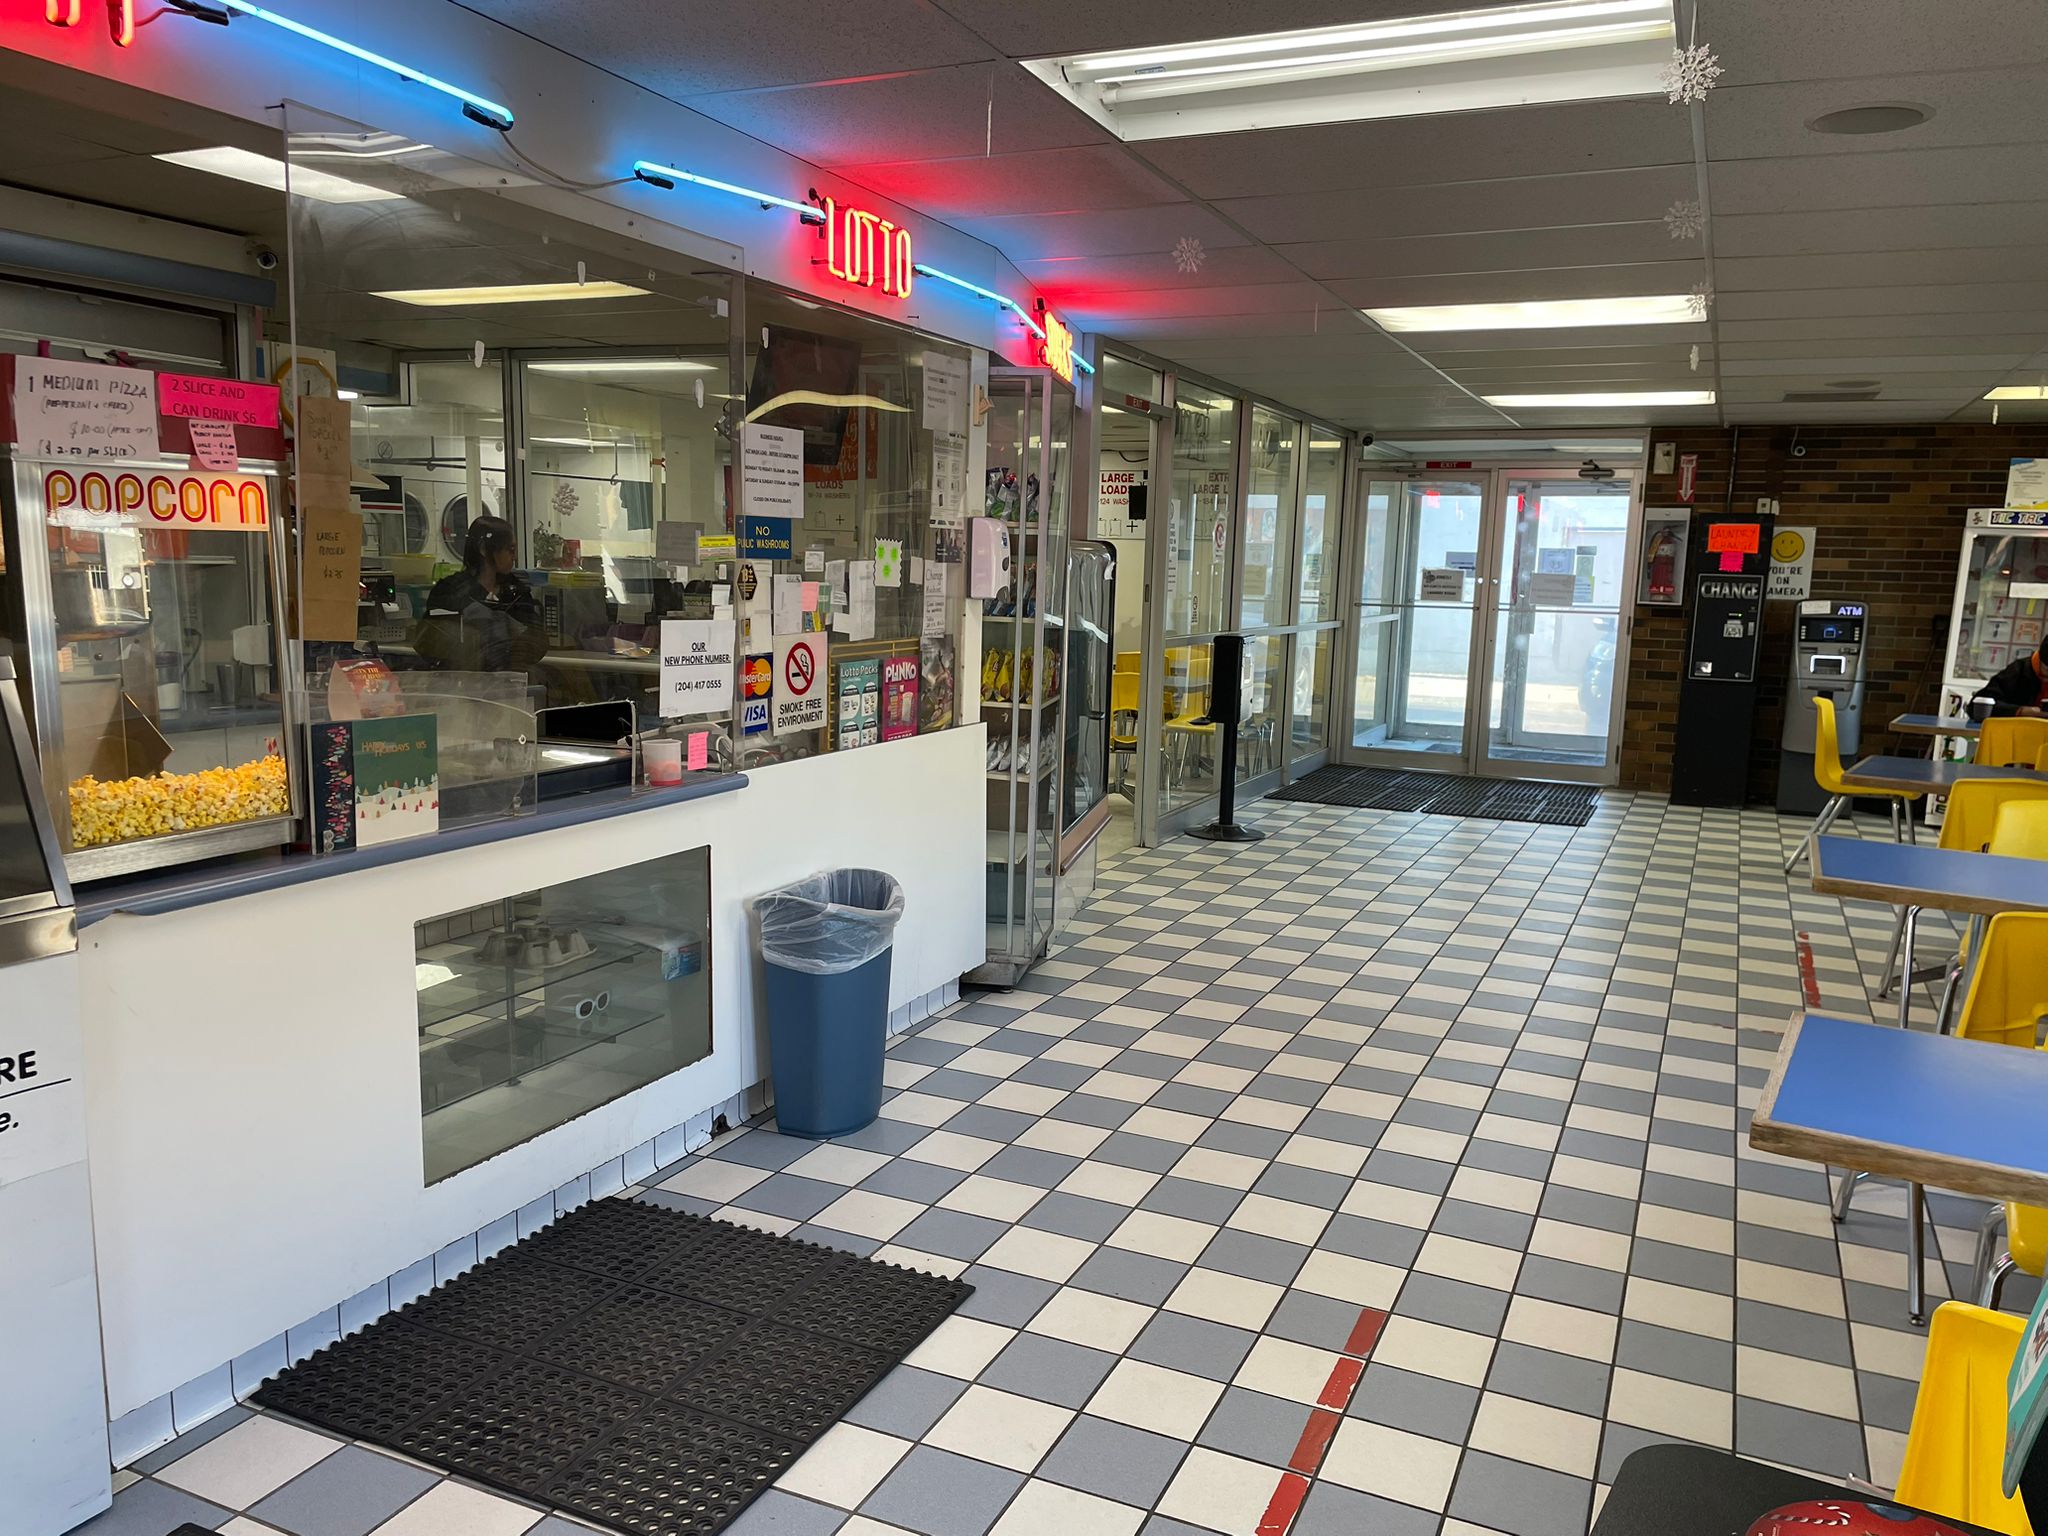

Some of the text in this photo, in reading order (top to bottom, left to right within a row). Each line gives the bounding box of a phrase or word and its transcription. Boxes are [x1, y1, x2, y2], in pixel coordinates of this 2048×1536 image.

[825, 196, 912, 299] LOTTO
[28, 375, 148, 398] 1 MEDIUM PIZZA
[172, 379, 246, 400] 2 SLICE AND
[172, 402, 257, 424] CAN DRINK $6
[1101, 473, 1135, 483] LARGE
[816, 480, 844, 489] LOADS
[1101, 484, 1130, 495] LOAD
[1193, 484, 1219, 494] LARGE
[1992, 512, 2046, 525] TIC TAC
[755, 526, 770, 536] NO
[1710, 528, 1756, 540] LAUNDRY
[316, 532, 341, 542] LARGE
[756, 539, 790, 550] WASHROOMS
[1776, 576, 1790, 585] ON
[1701, 582, 1759, 600] CHANGE
[1767, 587, 1804, 596] AMERA
[1838, 606, 1862, 616] ATM
[692, 642, 706, 652] OUR
[664, 656, 680, 666] NEW
[681, 655, 704, 665] PHONE
[840, 665, 878, 678] Lotto Packs
[885, 662, 917, 683] PLINKO
[674, 680, 722, 693] (204) 417 0555
[780, 698, 822, 715] SMOKE FREE
[778, 710, 824, 728] ENVIRONMENT
